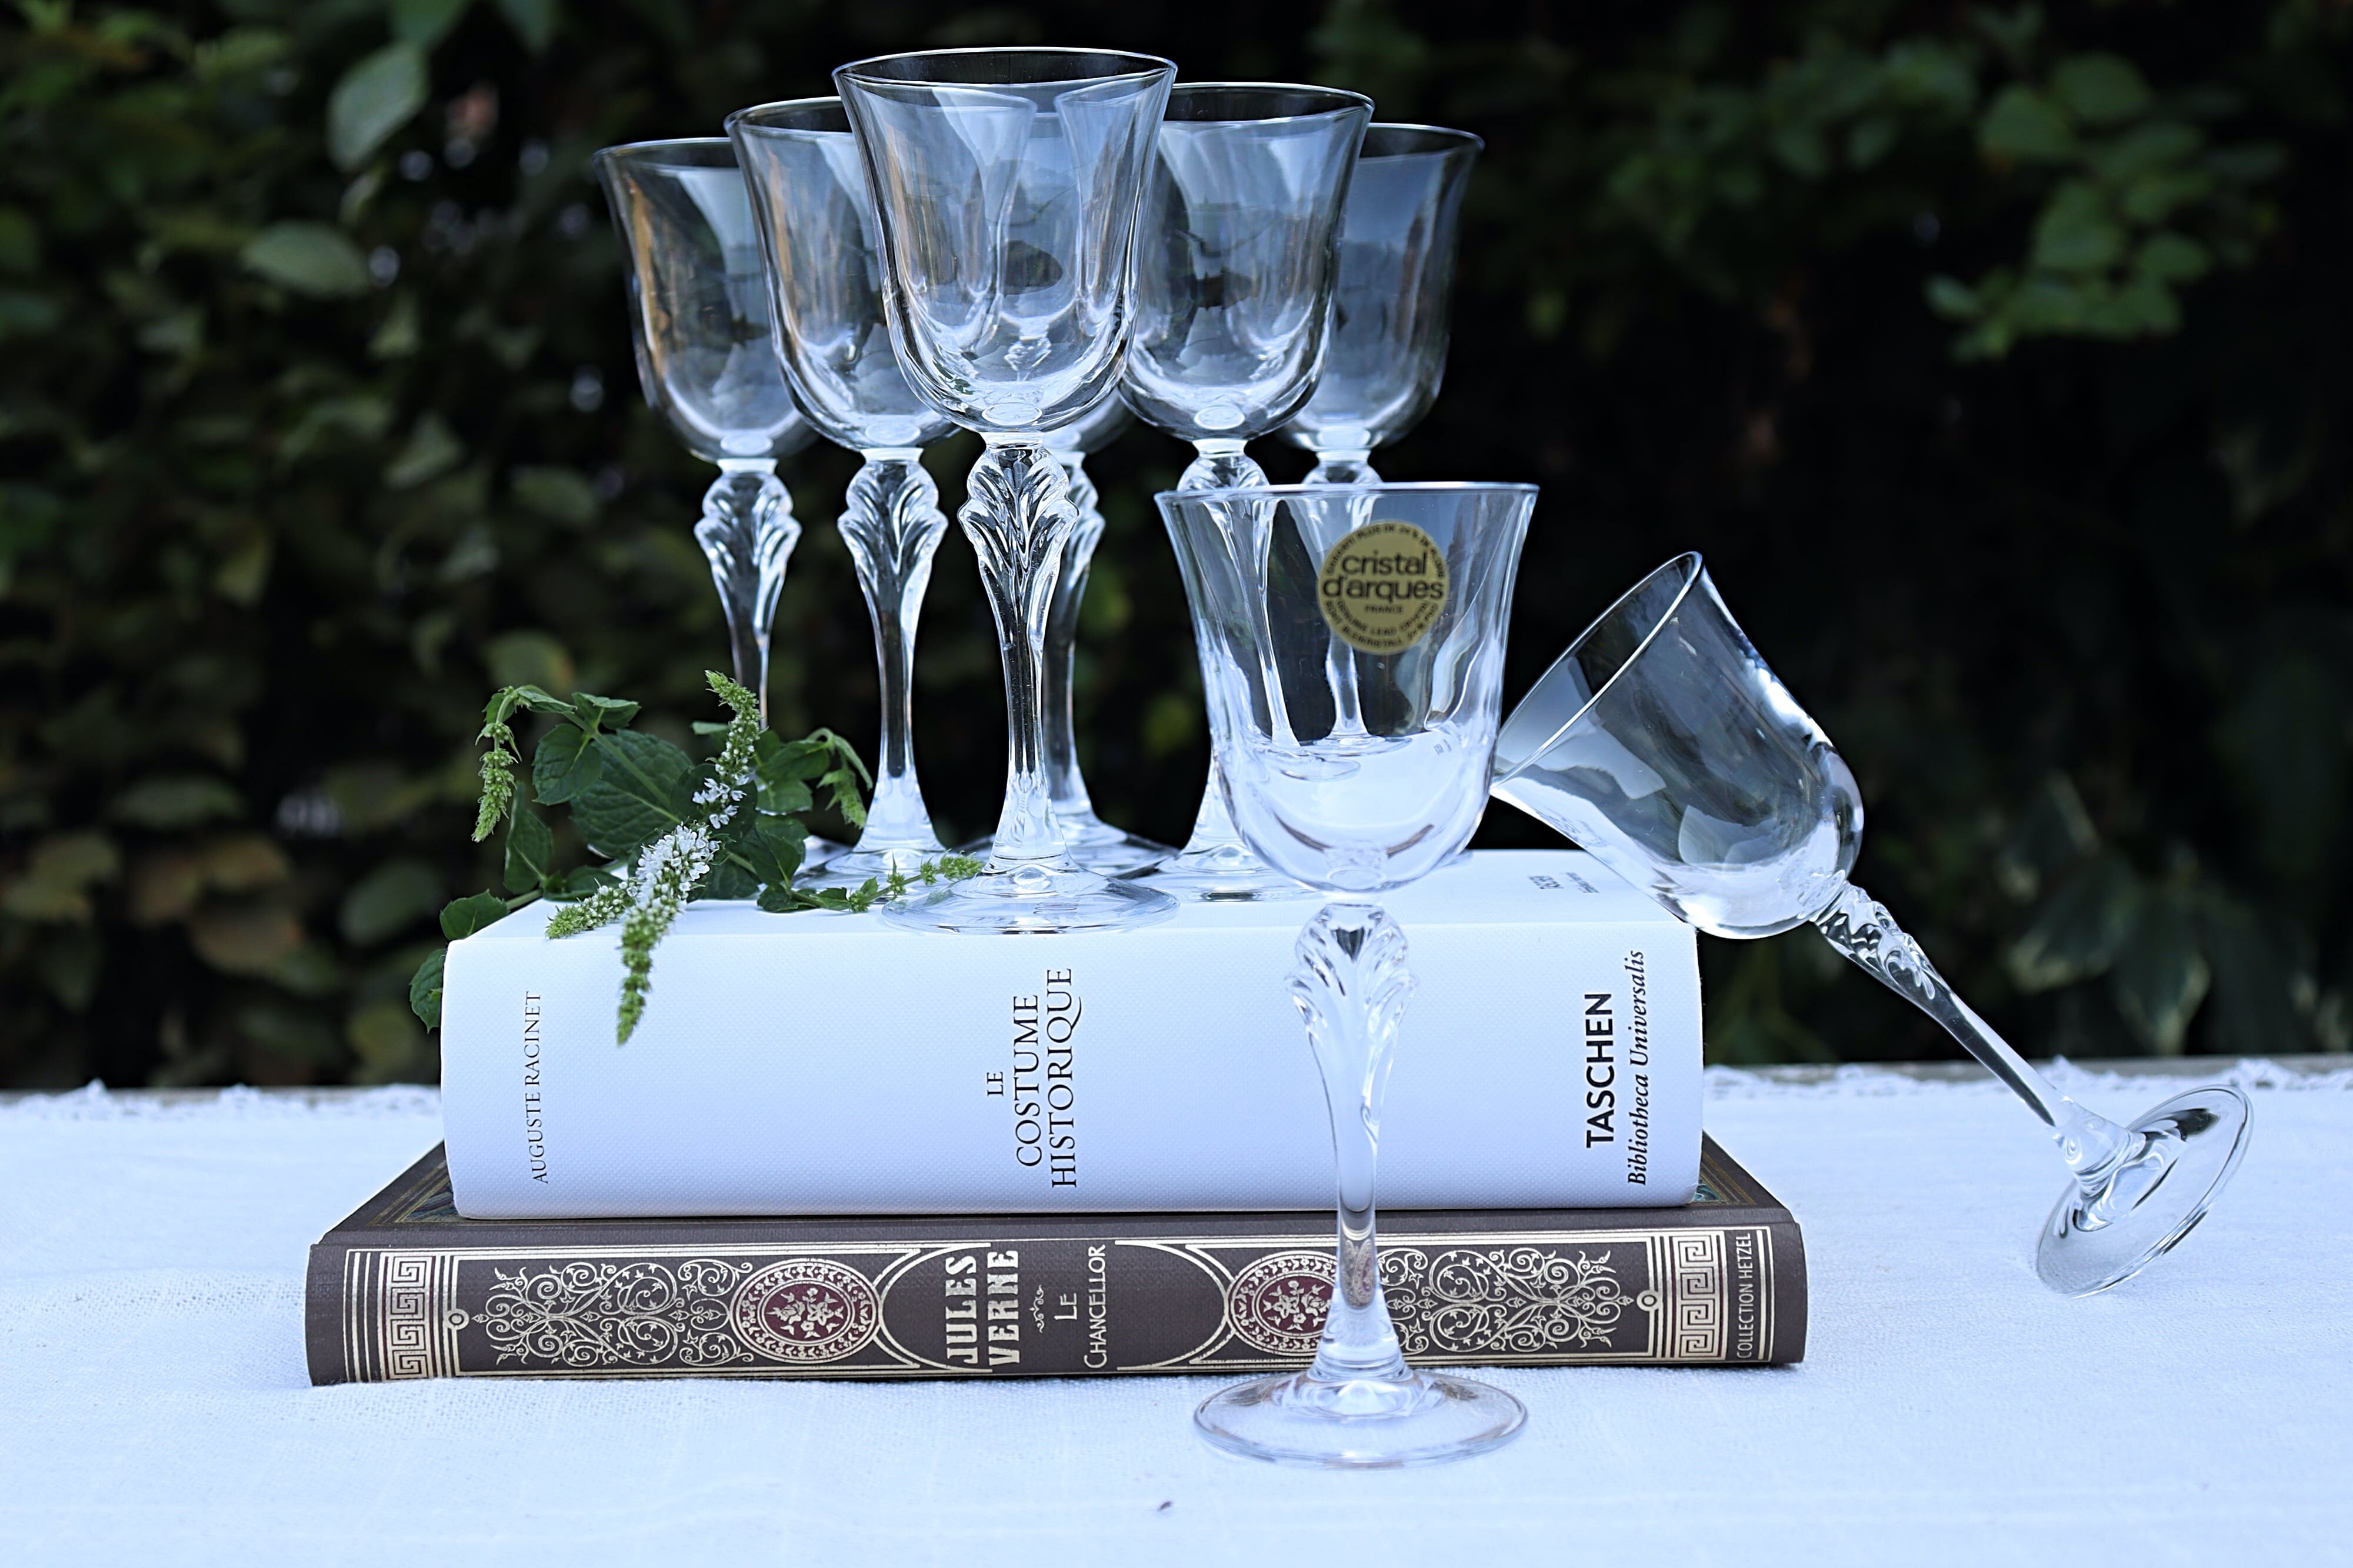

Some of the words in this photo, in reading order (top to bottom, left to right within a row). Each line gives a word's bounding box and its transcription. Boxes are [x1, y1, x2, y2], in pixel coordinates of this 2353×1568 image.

[1322, 575, 1444, 603] d'arques
[1341, 549, 1428, 575] cristal
[524, 991, 541, 1086] RACINET
[1625, 950, 1648, 1067] Universalis
[986, 1072, 1004, 1097] LE
[1013, 995, 1042, 1167] COSTUME
[1046, 968, 1082, 1188] HISTORIQUE
[1584, 994, 1614, 1149] TASCHEN
[525, 1092, 548, 1184] AUGUSTE
[1627, 1074, 1649, 1186] Bibliotheca
[1735, 1233, 1753, 1279] HETZEL
[945, 1255, 978, 1365] JULES
[986, 1250, 1021, 1366] VERNE
[1737, 1283, 1754, 1359] COLLECTION
